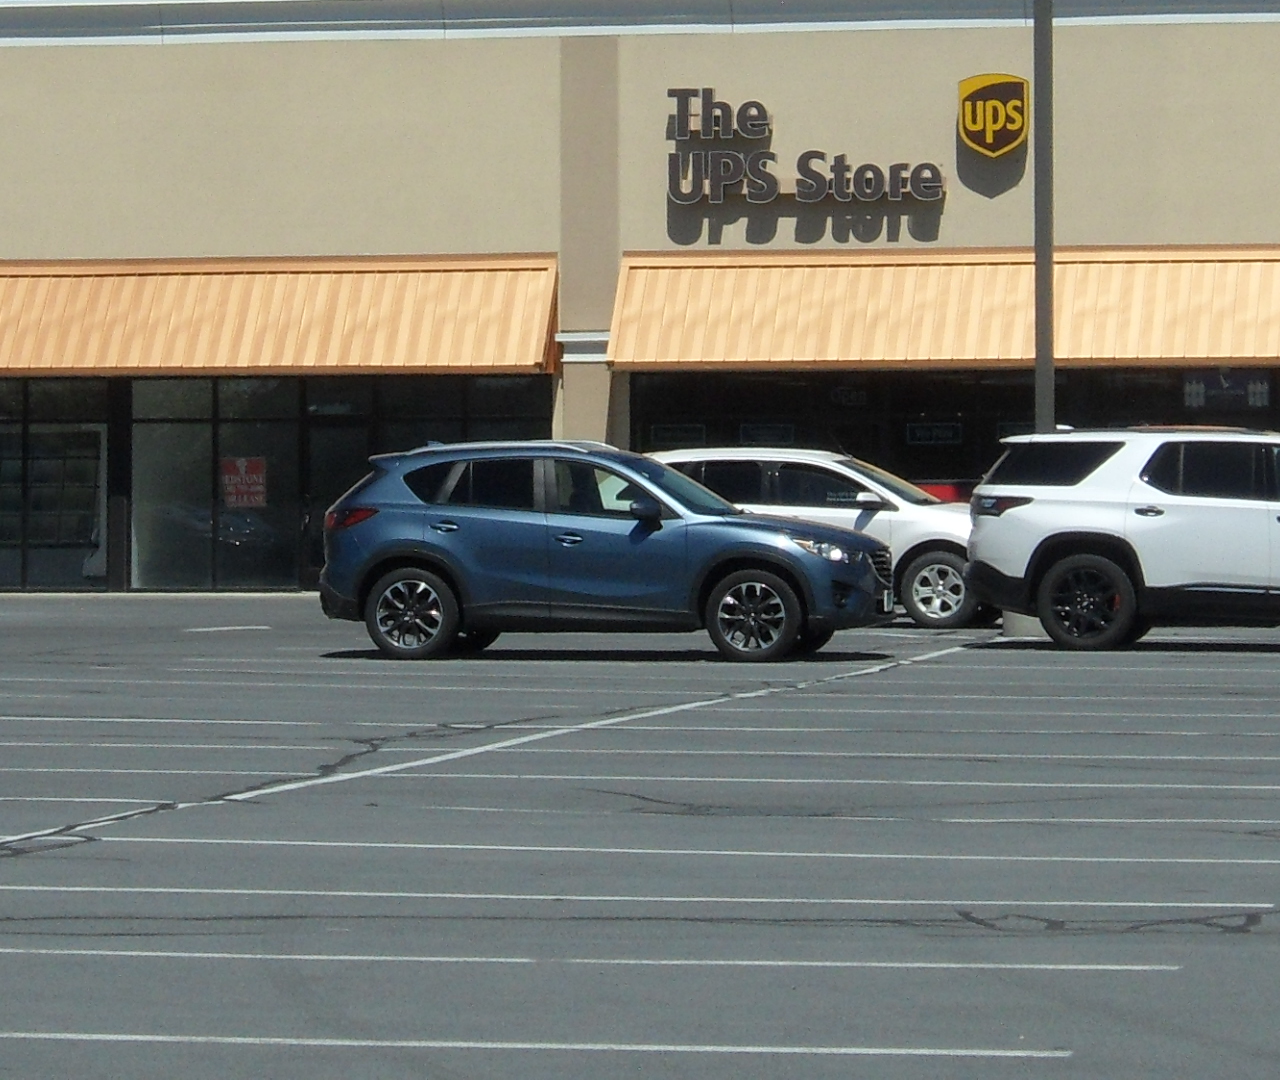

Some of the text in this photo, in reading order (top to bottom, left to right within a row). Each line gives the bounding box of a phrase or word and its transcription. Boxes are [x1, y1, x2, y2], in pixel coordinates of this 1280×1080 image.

[667, 87, 771, 140] The
[964, 98, 1023, 143] ups
[667, 150, 944, 204] UPS Store
